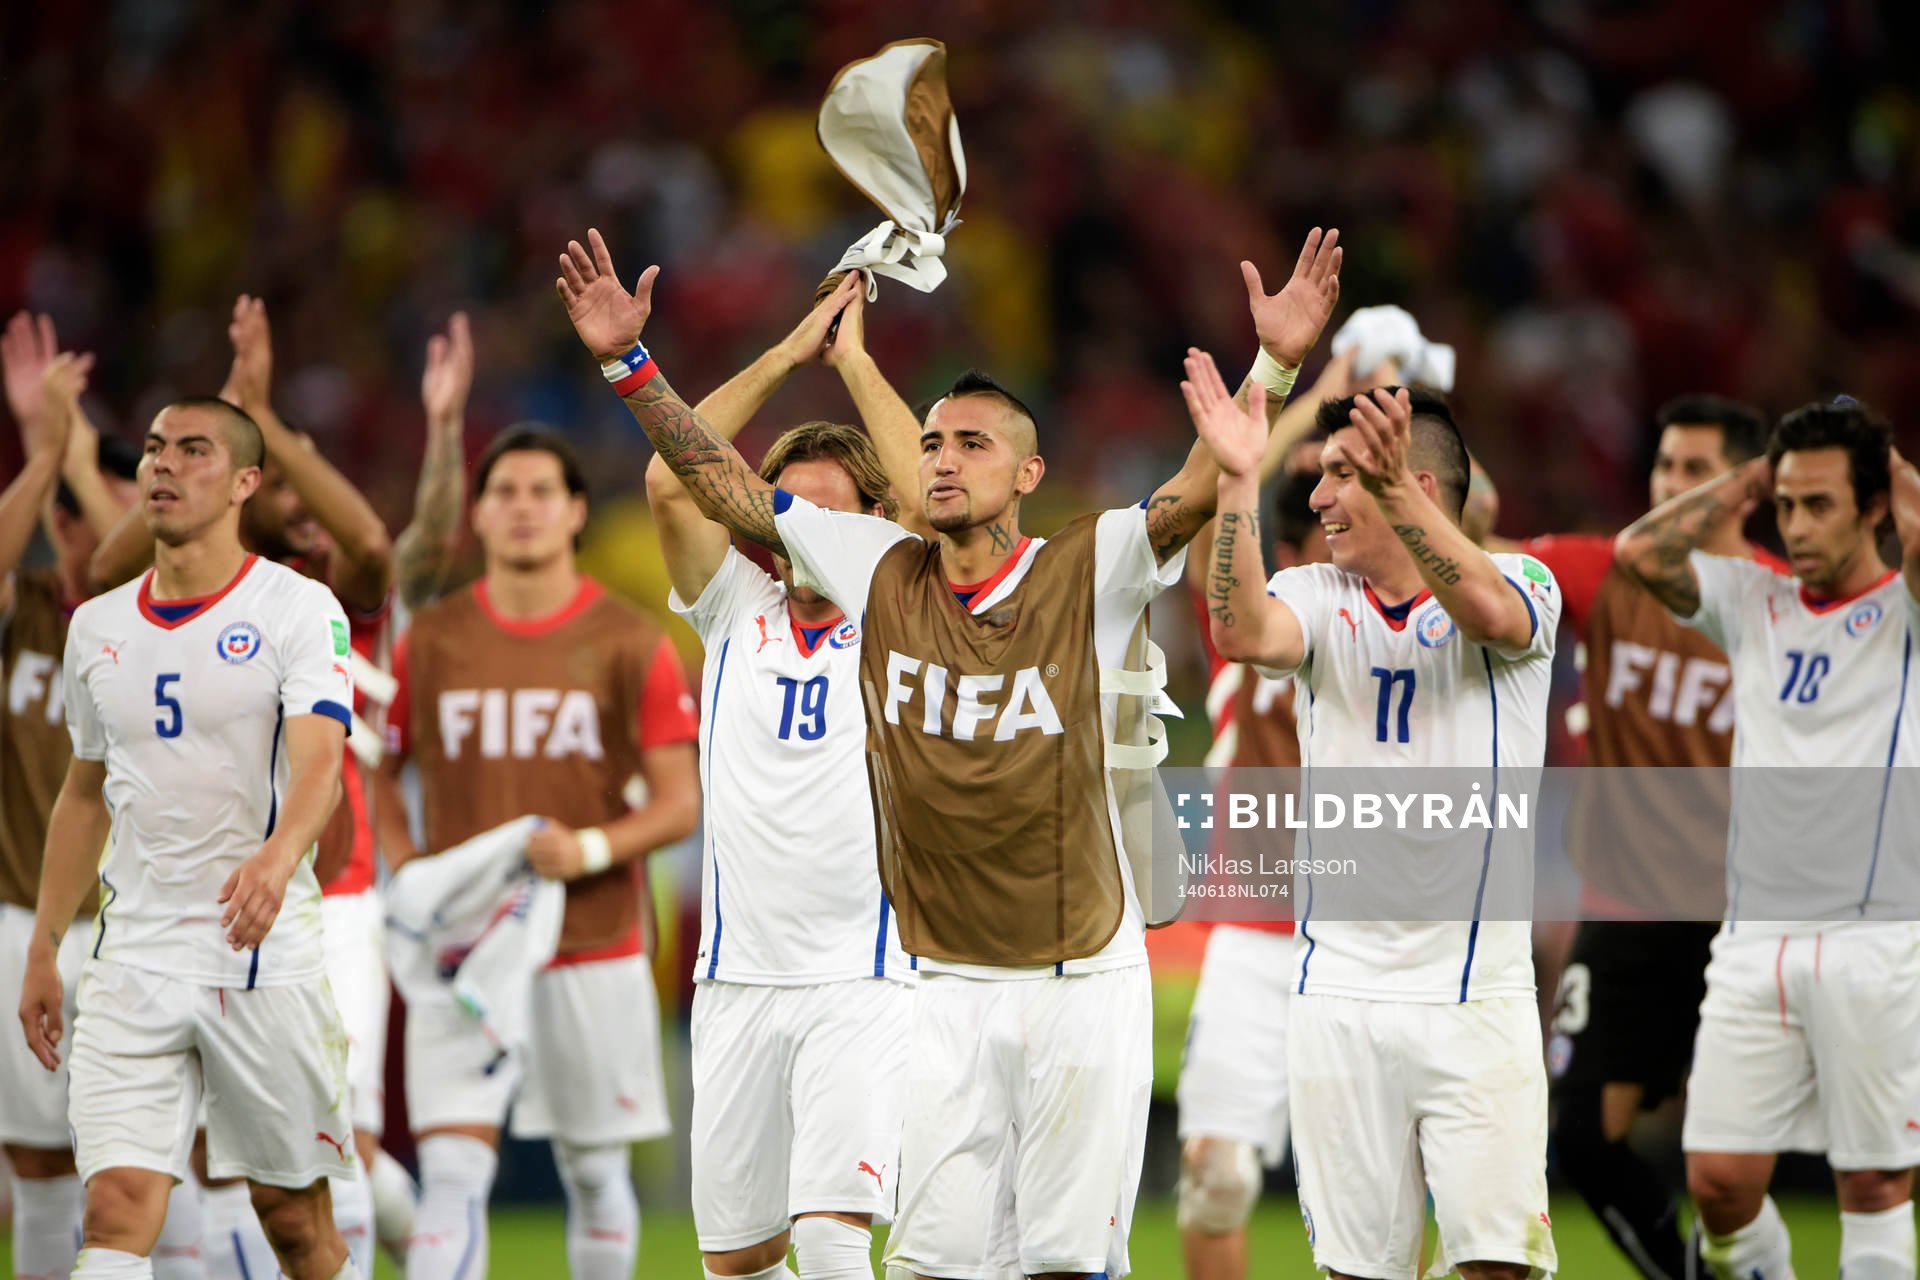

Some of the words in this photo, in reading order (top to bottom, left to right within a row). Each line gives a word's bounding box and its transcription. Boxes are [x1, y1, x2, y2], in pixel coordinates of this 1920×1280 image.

[155, 672, 183, 738] 5
[437, 687, 604, 761] FIFA
[776, 675, 830, 740] 19
[1371, 666, 1416, 743] 11
